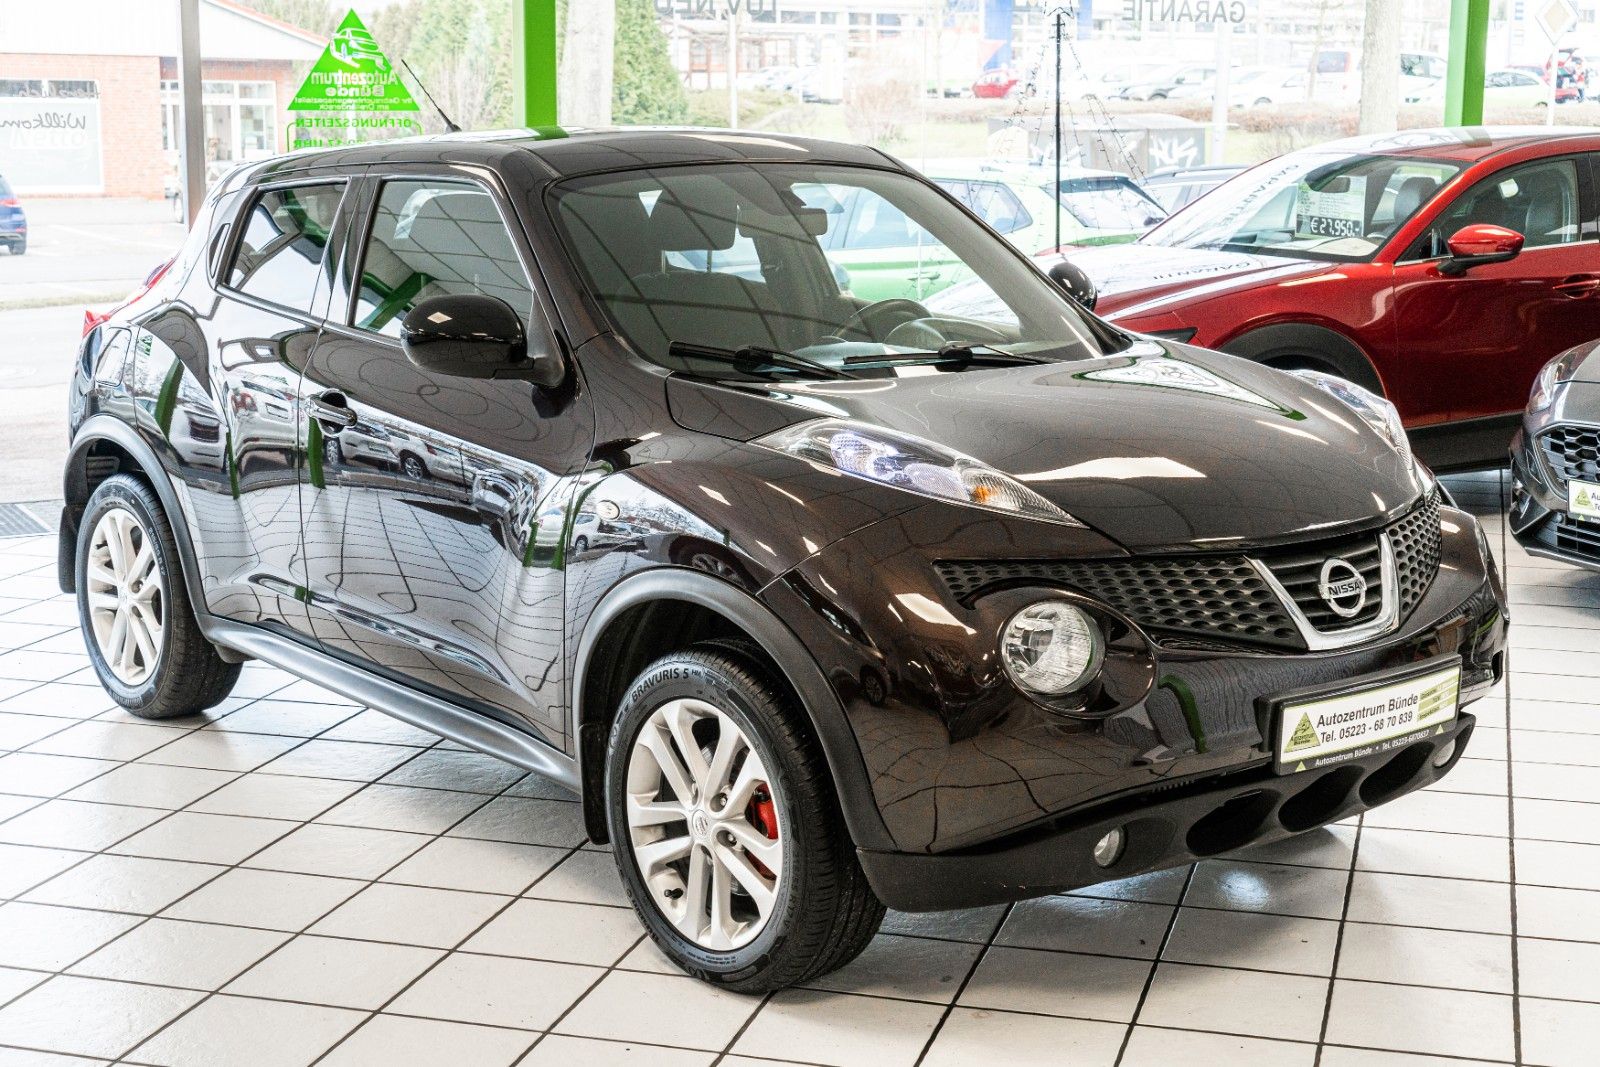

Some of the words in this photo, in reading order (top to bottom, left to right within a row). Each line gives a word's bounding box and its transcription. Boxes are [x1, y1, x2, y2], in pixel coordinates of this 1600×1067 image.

[631, 667, 680, 702] BRAVURIS
[682, 668, 689, 679] 5
[1316, 703, 1385, 728] Autozentrum
[1388, 694, 1418, 712] Bünde
[1321, 731, 1337, 744] Tel.
[1339, 723, 1367, 740] 05223
[1374, 719, 1385, 732] 68
[1387, 715, 1397, 728] 70
[1399, 711, 1413, 725] 839
[1315, 752, 1354, 767] Autozentrum
[1354, 746, 1373, 758] Bünde
